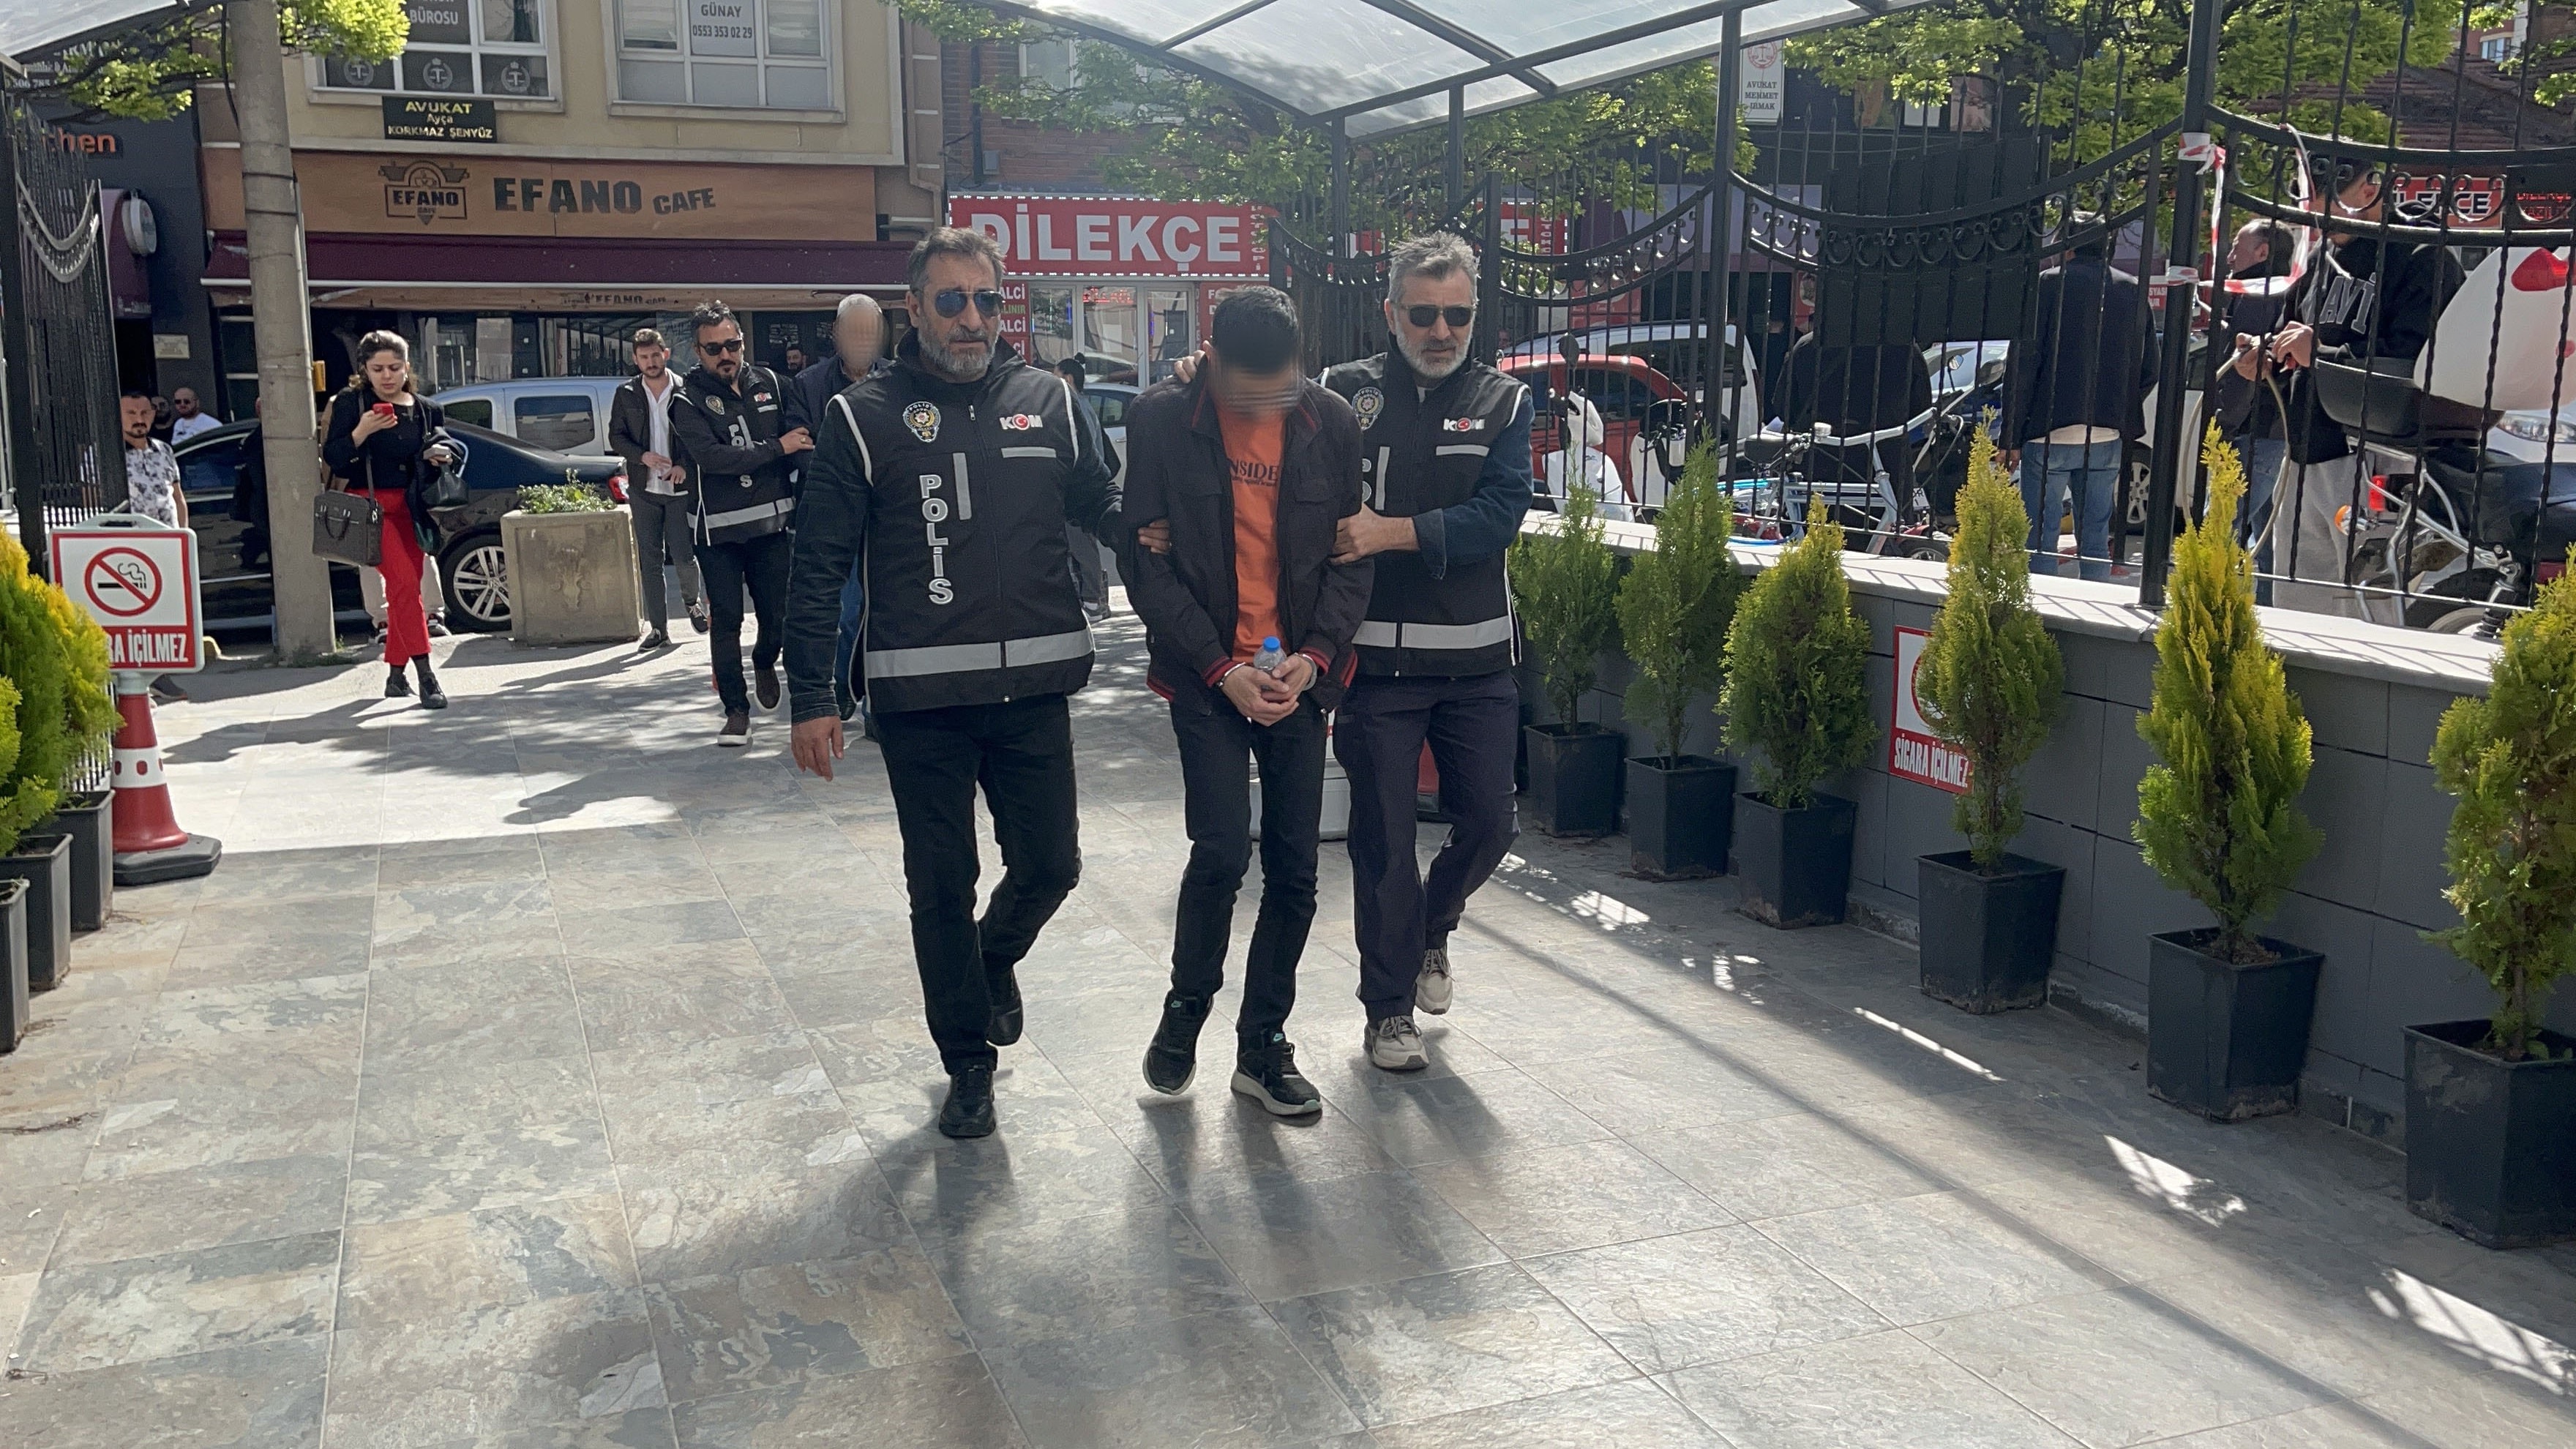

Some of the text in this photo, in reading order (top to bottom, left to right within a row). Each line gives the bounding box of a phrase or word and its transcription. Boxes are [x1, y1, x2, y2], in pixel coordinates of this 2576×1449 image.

[410, 6, 459, 25] BÜROSU
[700, 1, 742, 18] GÜNAY
[692, 25, 753, 38] 0553 353 02 29
[1746, 80, 1778, 89] AVUKAT
[1744, 91, 1779, 100] MEHMET
[405, 101, 473, 114] AVUKAT
[427, 113, 454, 125] Ayça
[388, 125, 493, 139] KORKMAZ ŞENYÜZ
[392, 190, 459, 206] EFANO
[493, 177, 716, 215] EFANO CAFE
[971, 203, 1241, 272] DİLEKÇE
[1000, 413, 1043, 430] KOM
[919, 474, 954, 604] POLİS
[127, 629, 189, 667] İÇİLMEZ
[1894, 733, 1969, 788] SİGARA İÇİLMEZ
